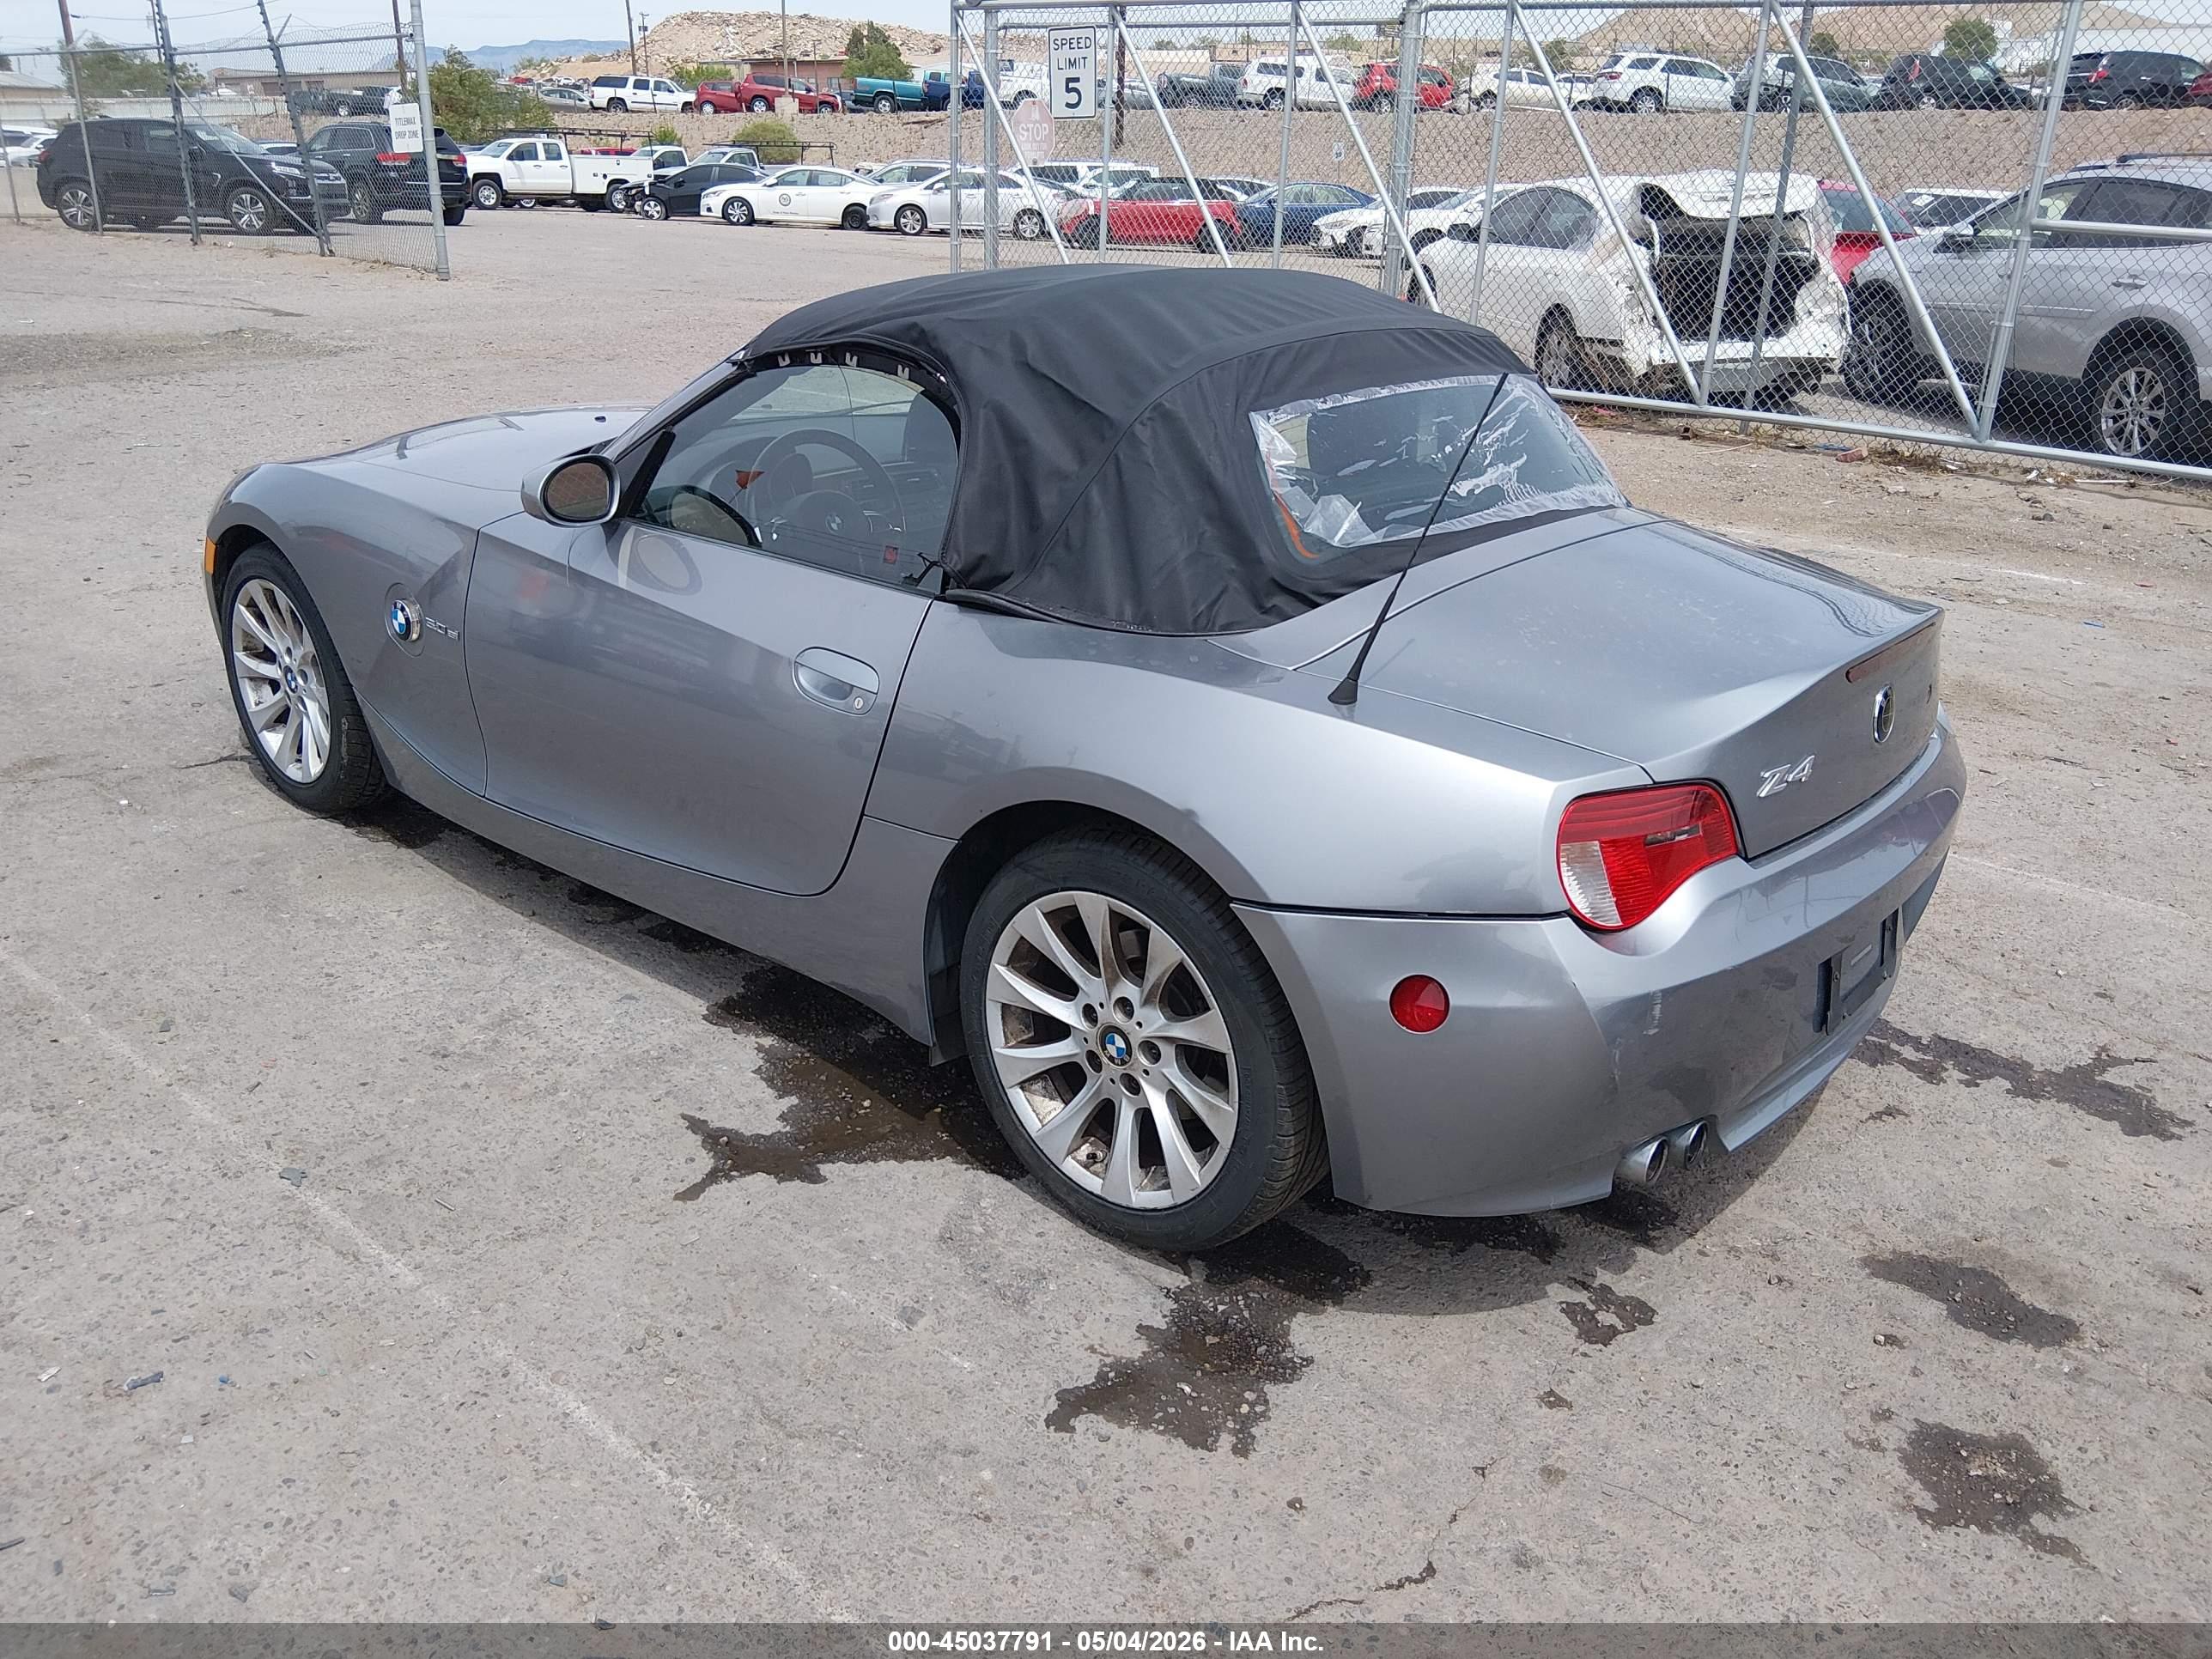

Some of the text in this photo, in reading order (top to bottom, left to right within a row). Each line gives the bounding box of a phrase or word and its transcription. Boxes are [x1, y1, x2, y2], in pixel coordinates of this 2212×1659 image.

[1053, 36, 1092, 51] SPEED
[1057, 57, 1088, 70] LIMIT
[1065, 76, 1082, 109] 5
[395, 130, 420, 139] DROP ZONE
[1019, 123, 1049, 141] STOP
[1756, 755, 1815, 798] Z4
